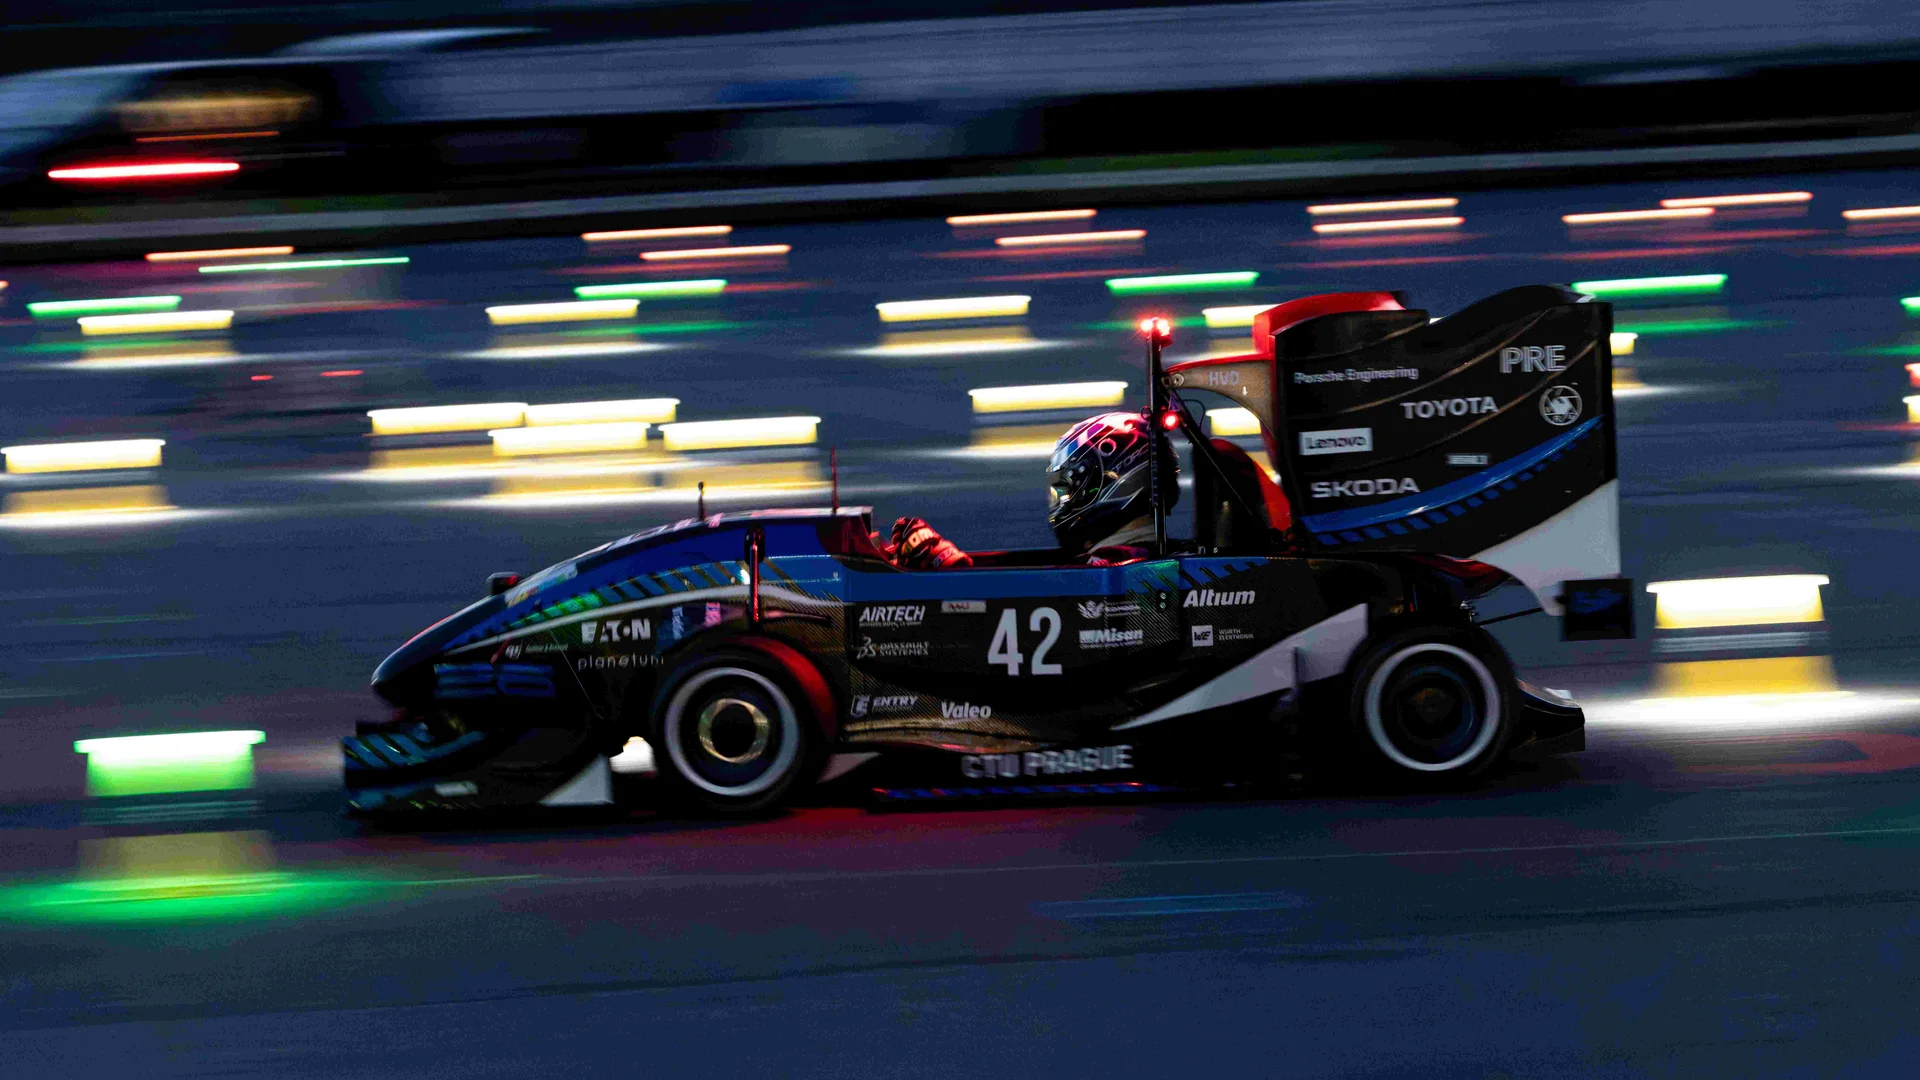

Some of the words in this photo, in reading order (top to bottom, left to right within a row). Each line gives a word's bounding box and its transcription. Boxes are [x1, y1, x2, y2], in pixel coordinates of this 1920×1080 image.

[1499, 345, 1567, 374] PRE
[1293, 370, 1345, 384] Porsche
[1345, 366, 1420, 382] Engineering
[1400, 396, 1499, 419] TOYOTA
[1304, 436, 1367, 450] Lenovo
[1183, 589, 1256, 608] Altium
[859, 604, 926, 622] AIRTECH
[987, 606, 1063, 676] 42
[873, 695, 919, 707] ENTRY
[941, 701, 991, 719] Valeo
[960, 753, 1021, 779] CTU
[1023, 744, 1135, 777] PRAGUE
